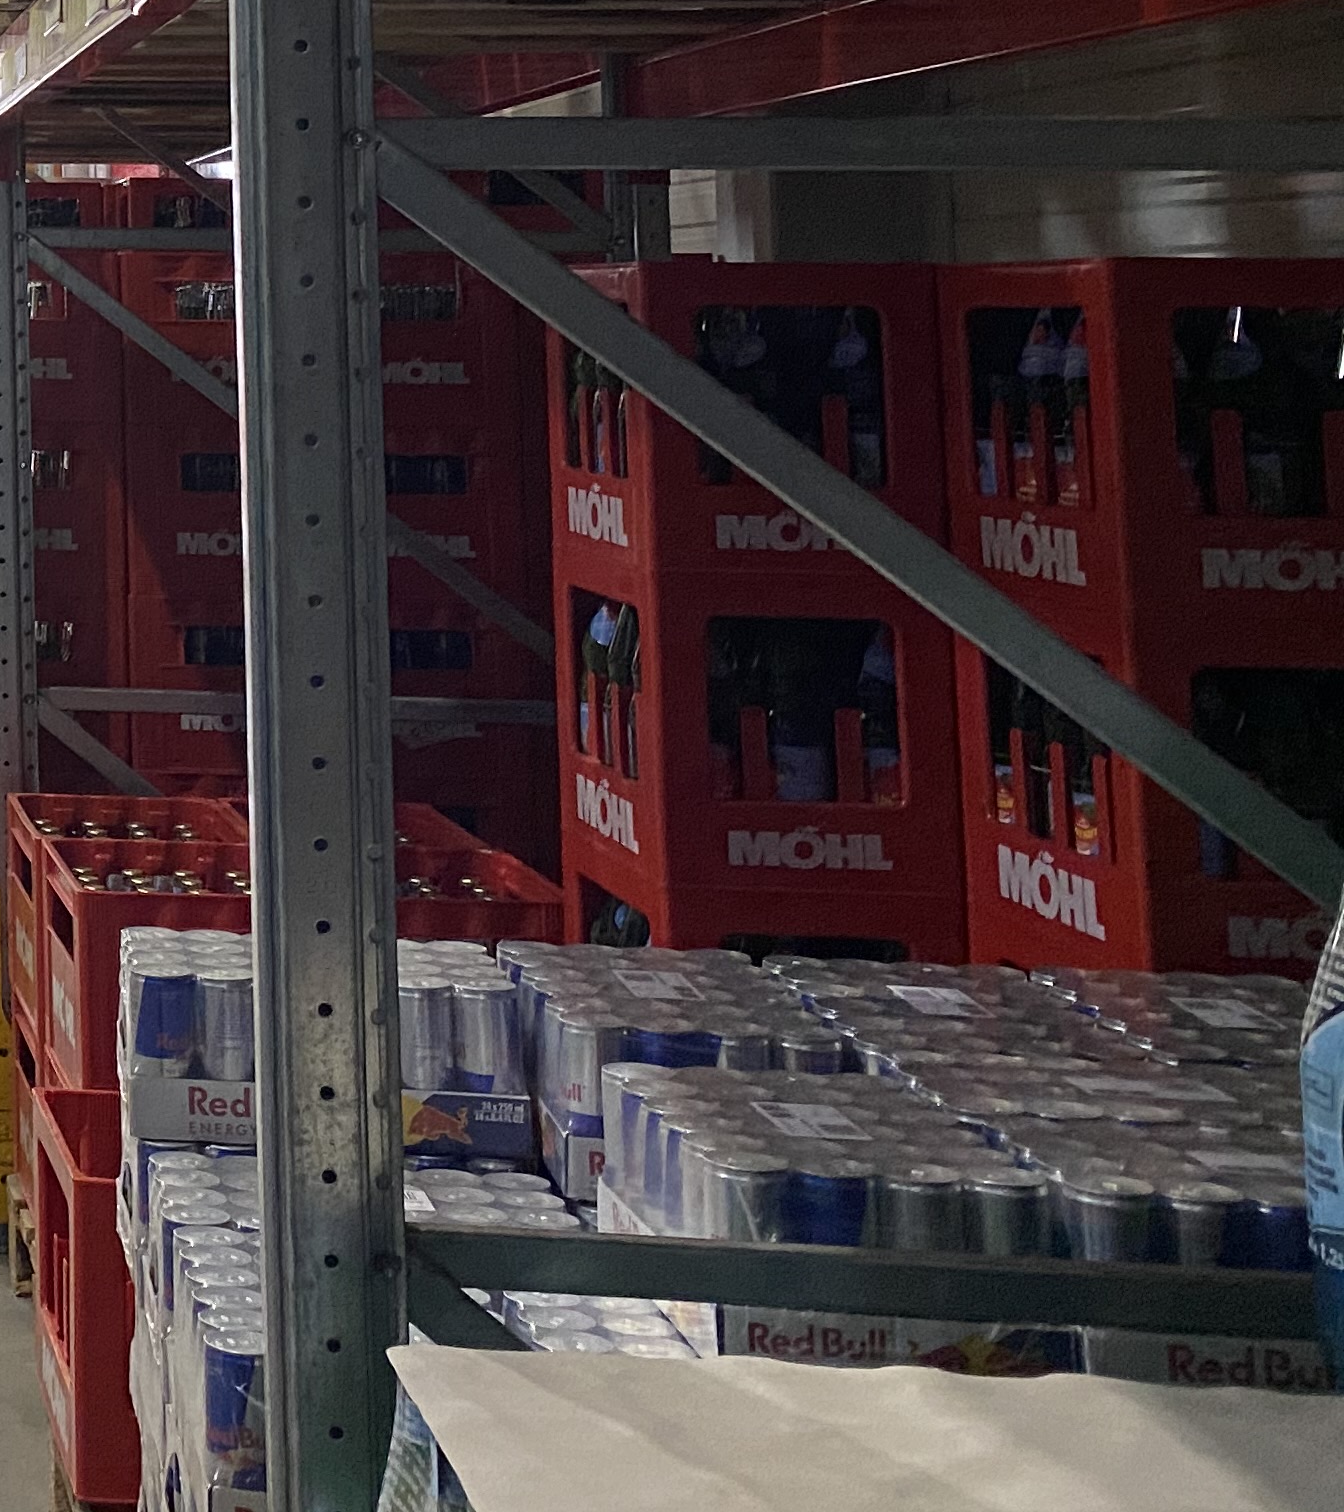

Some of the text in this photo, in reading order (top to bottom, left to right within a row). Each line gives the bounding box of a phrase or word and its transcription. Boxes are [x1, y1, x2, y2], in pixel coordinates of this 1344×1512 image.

[188, 1086, 251, 1118] Red
[748, 1322, 886, 1361] Red Bull
[1168, 1343, 1252, 1384] Red
